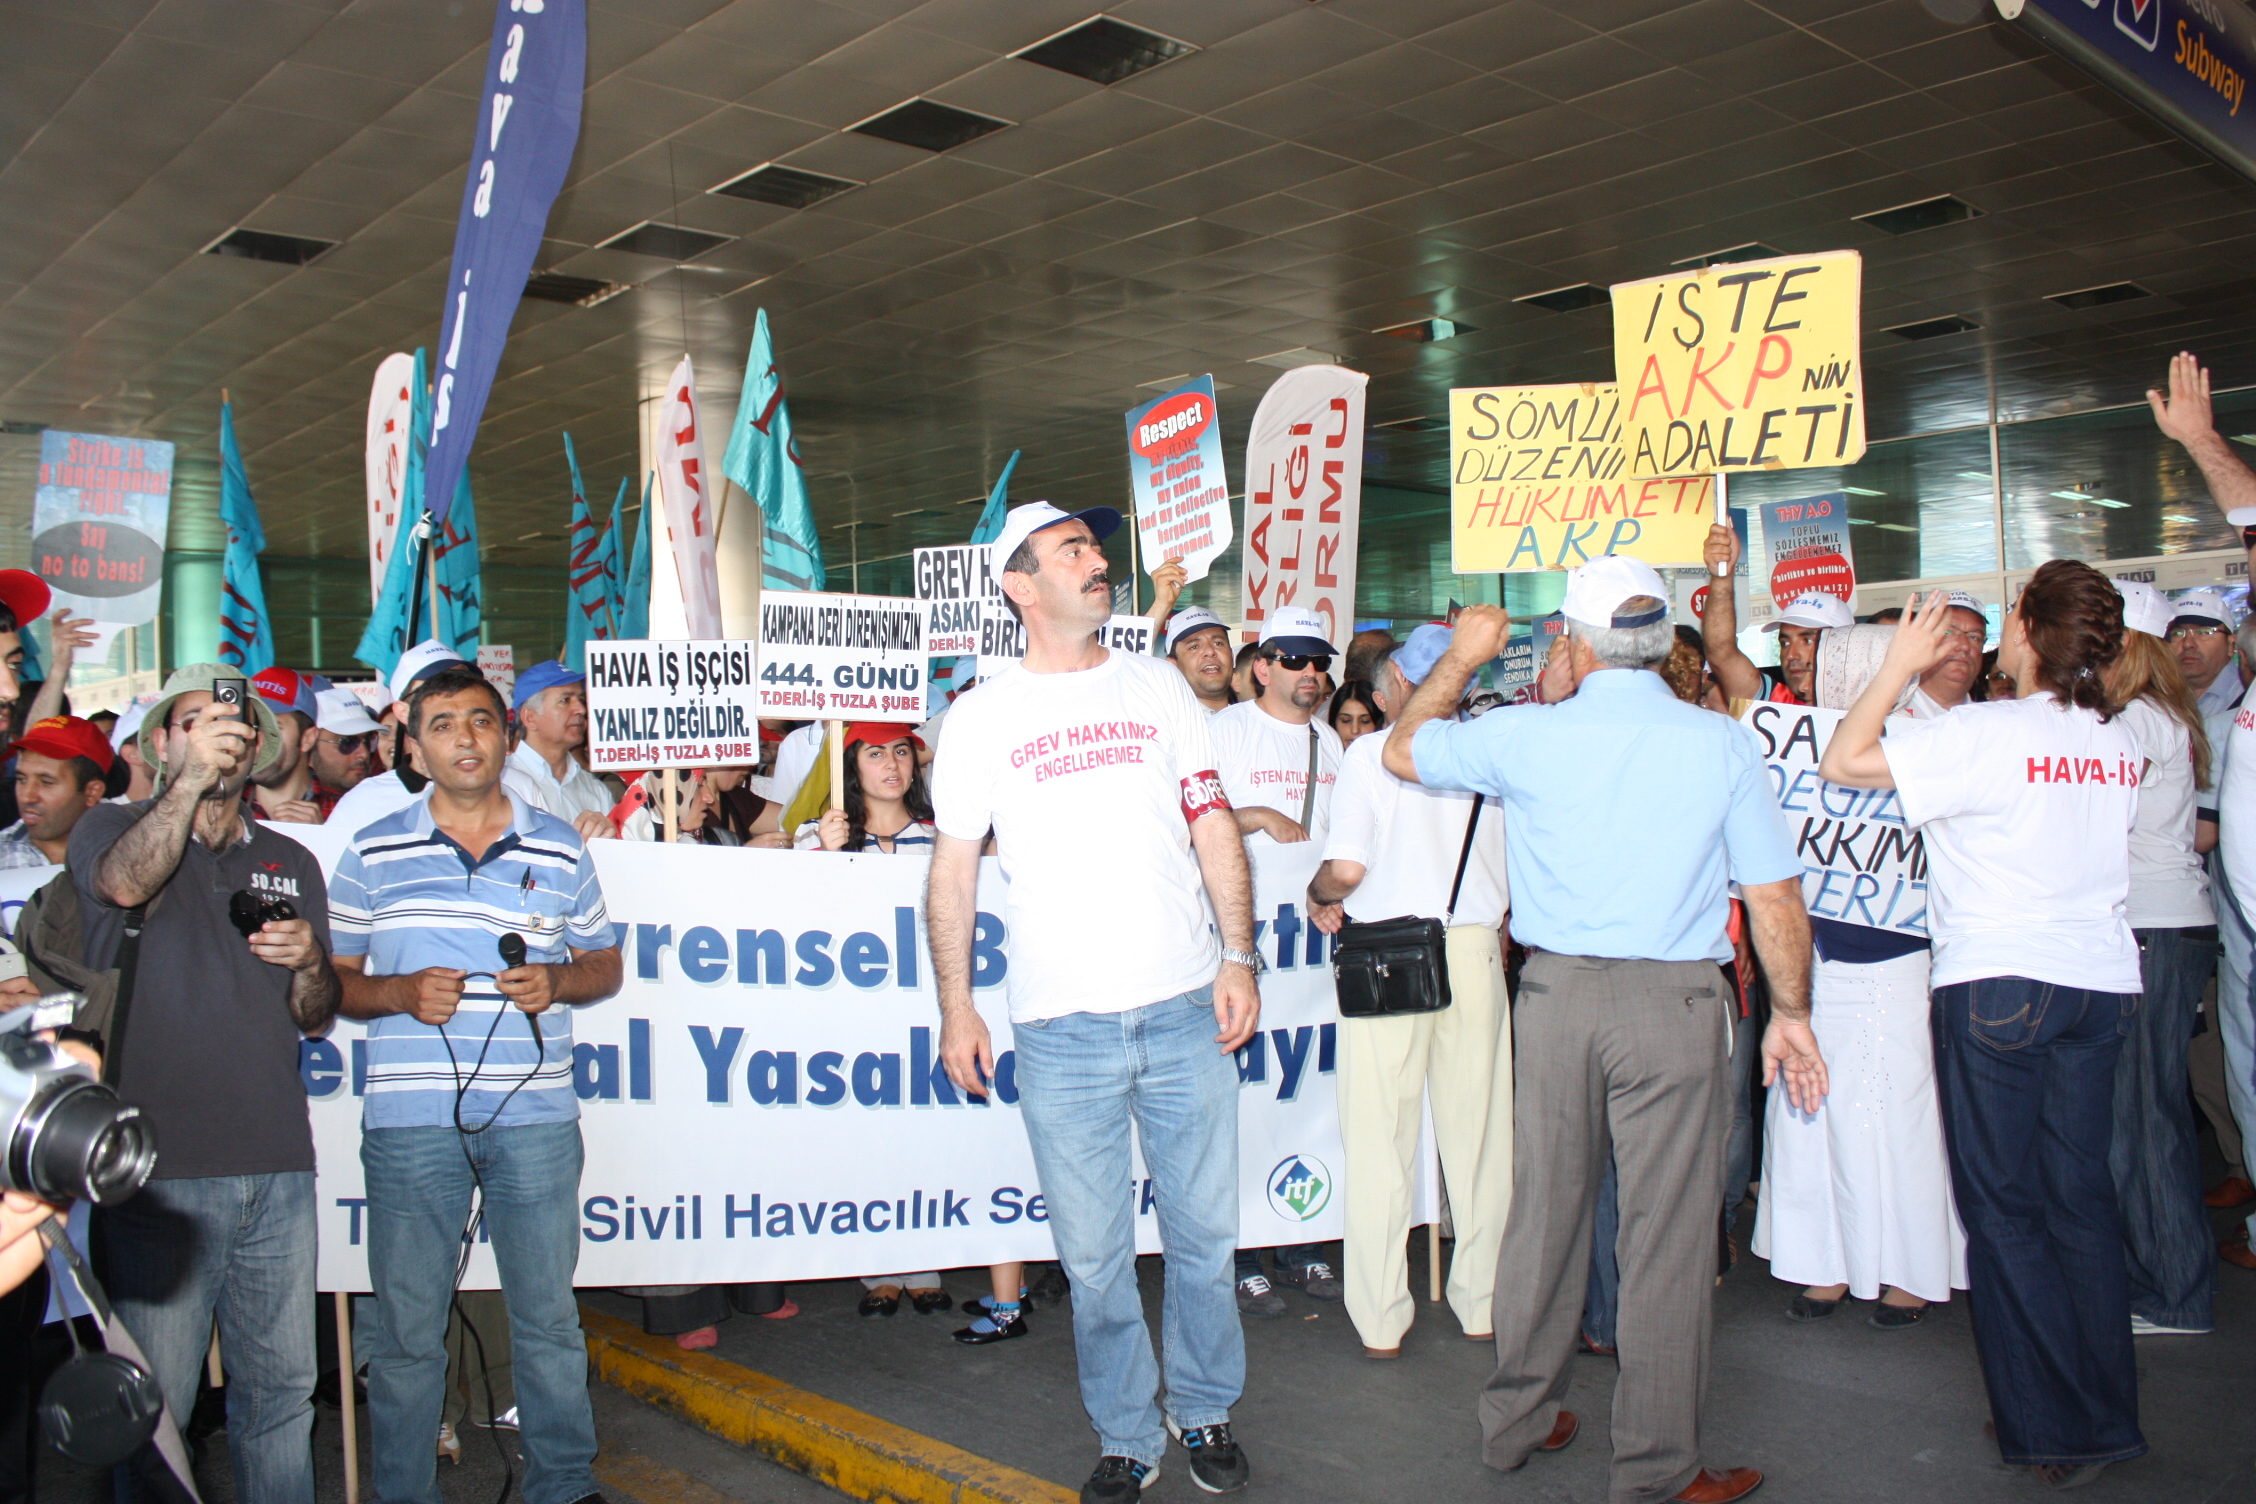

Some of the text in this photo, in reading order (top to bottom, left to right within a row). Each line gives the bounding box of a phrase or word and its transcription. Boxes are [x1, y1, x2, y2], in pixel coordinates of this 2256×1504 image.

[2175, 19, 2245, 117] Subway
[474, 0, 544, 218] ava
[1643, 265, 1822, 353] İŞTE
[1629, 334, 1851, 422] AKP NİN
[1139, 401, 1204, 449] Respect
[1466, 389, 1623, 444] SÖMÜ
[1634, 392, 1855, 475] ADALETİ
[68, 438, 146, 470] Strike is
[39, 461, 169, 496] a fundamental
[1150, 470, 1165, 488] my
[1157, 474, 1201, 505] my union
[79, 490, 130, 516] right.
[1140, 485, 1225, 533] and my collective
[1776, 500, 1833, 523] THY A.O
[81, 522, 108, 551] Say
[1507, 518, 1641, 568] AKP
[1791, 524, 1820, 537] TOPLU
[42, 554, 146, 583] no to bans!
[917, 548, 973, 600] GREV
[1807, 568, 1816, 576] ve
[2225, 563, 2249, 576] TA
[762, 598, 922, 660] KAMPANA DERİ DİRENİŞİMİZİN
[929, 634, 976, 653] DERİ-İŞ
[1543, 621, 1565, 635] THY
[590, 643, 751, 697] HAVA İŞ İŞÇİSİ
[761, 661, 920, 692] 444. GÜNÜ
[760, 689, 920, 713] T.DERİ-İŞ TUZLA ŞUBE
[593, 707, 660, 742] YANLIZ
[595, 743, 752, 765] T.DERİ-İŞ TUZLA ŞUBE
[1010, 731, 1061, 769] GREV
[1034, 745, 1144, 784] ENGELLENEMEZ
[1250, 768, 1283, 788] İŞTEN
[250, 872, 300, 897] SO.CAL
[582, 1193, 702, 1243] Sivil
[723, 1188, 971, 1239] Havacılık
